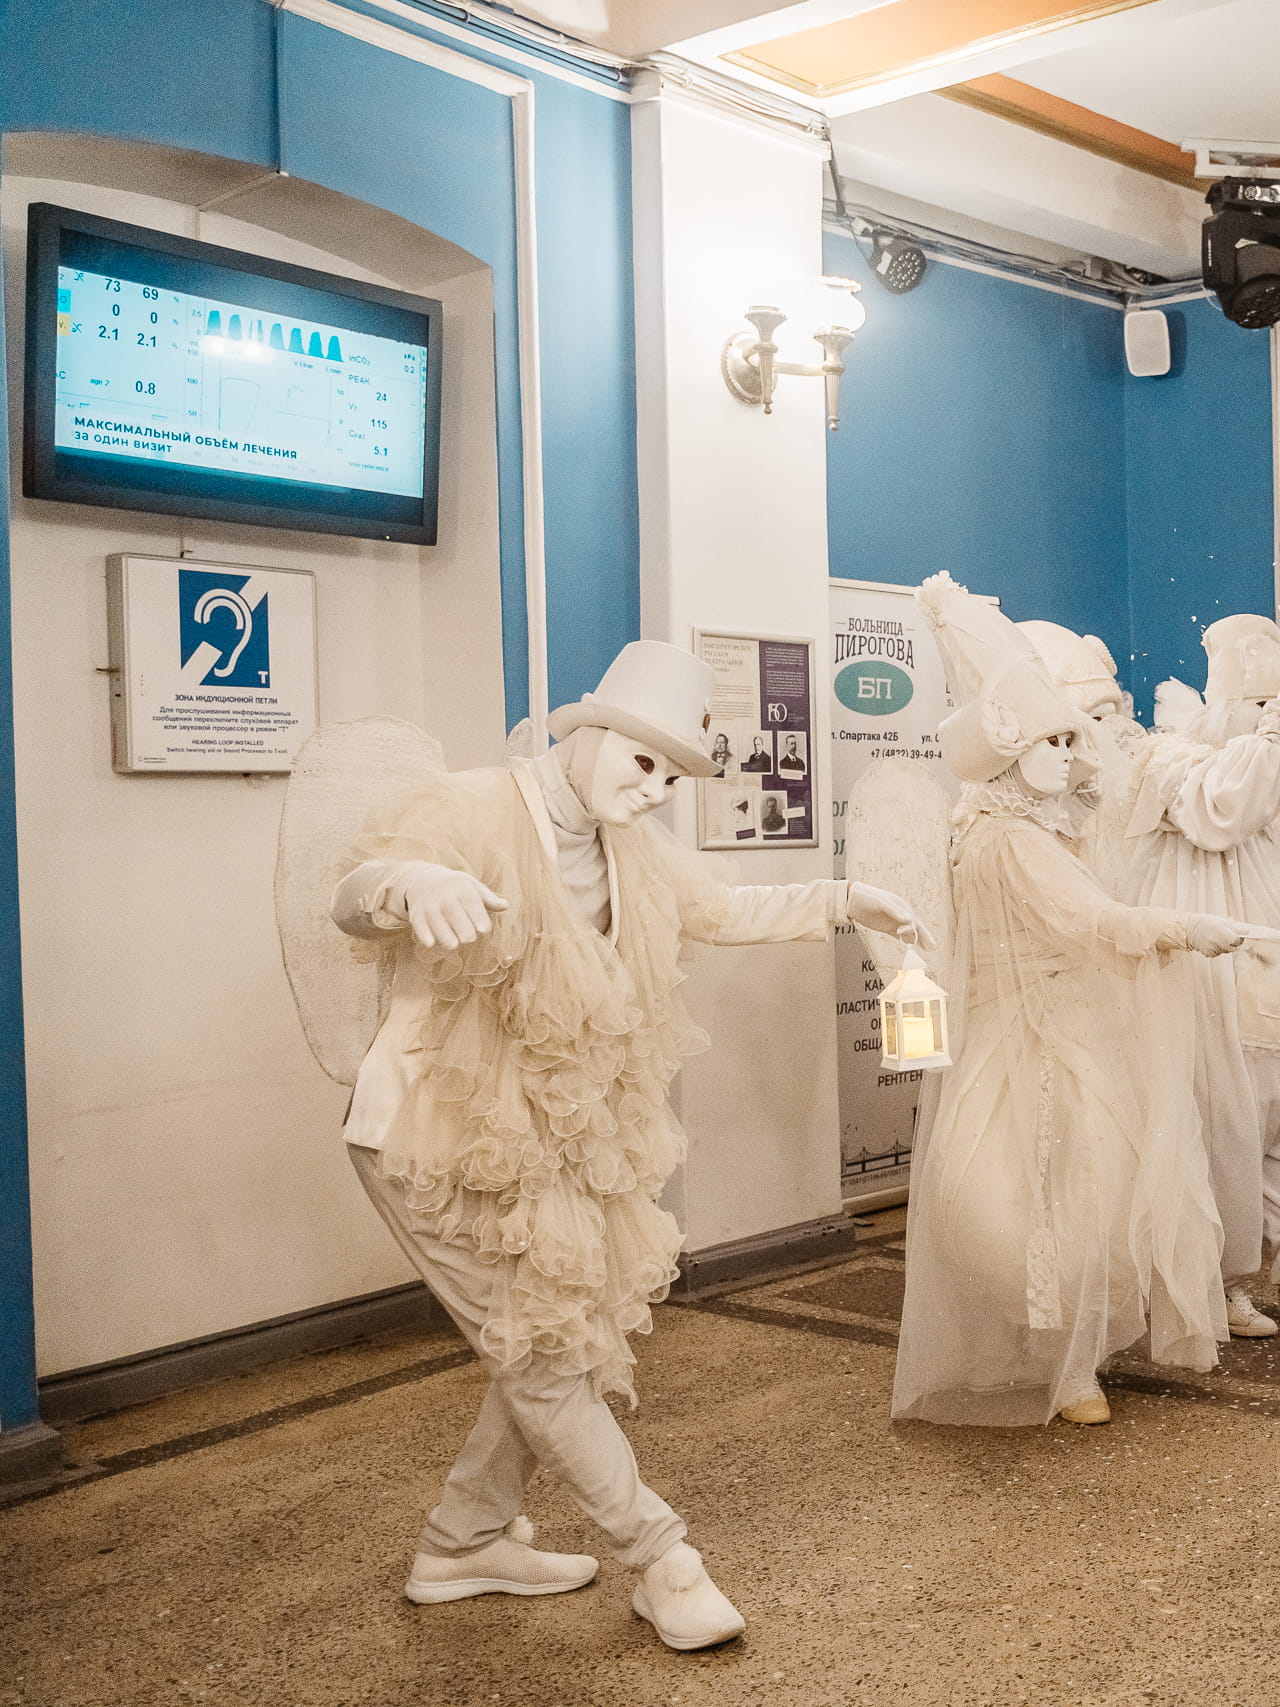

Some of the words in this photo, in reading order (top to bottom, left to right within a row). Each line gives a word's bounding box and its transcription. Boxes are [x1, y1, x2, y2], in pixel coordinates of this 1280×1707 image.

[105, 278, 121, 293] 73
[142, 287, 159, 301] 69
[112, 304, 120, 316] 0
[150, 312, 158, 324] 0
[98, 325, 119, 341] 2.1
[137, 333, 157, 348] 2.1
[135, 380, 156, 395] 0.8
[376, 391, 387, 402] 24
[371, 418, 388, 430] 115
[74, 416, 191, 443] МАКСИМАЛЬНЫЙ
[195, 435, 239, 451] ОБЪЁМ
[242, 443, 297, 460] ЛЕЧЕНИЯ
[93, 434, 129, 446] один
[133, 440, 173, 454] визит
[373, 445, 388, 457] 5.1
[848, 617, 904, 636] БОЛЬНИЦА
[834, 633, 915, 670] ПИРОГОВА
[857, 676, 893, 700] БП
[175, 693, 194, 702] ЗОНА
[195, 695, 254, 704] ИНДУКЦИОННОЙ
[255, 697, 278, 705] ПЕТЛИ
[839, 730, 881, 743] Спартака
[882, 731, 899, 742] 42Б
[870, 748, 881, 758] +7
[910, 749, 943, 760] 39-49-4
